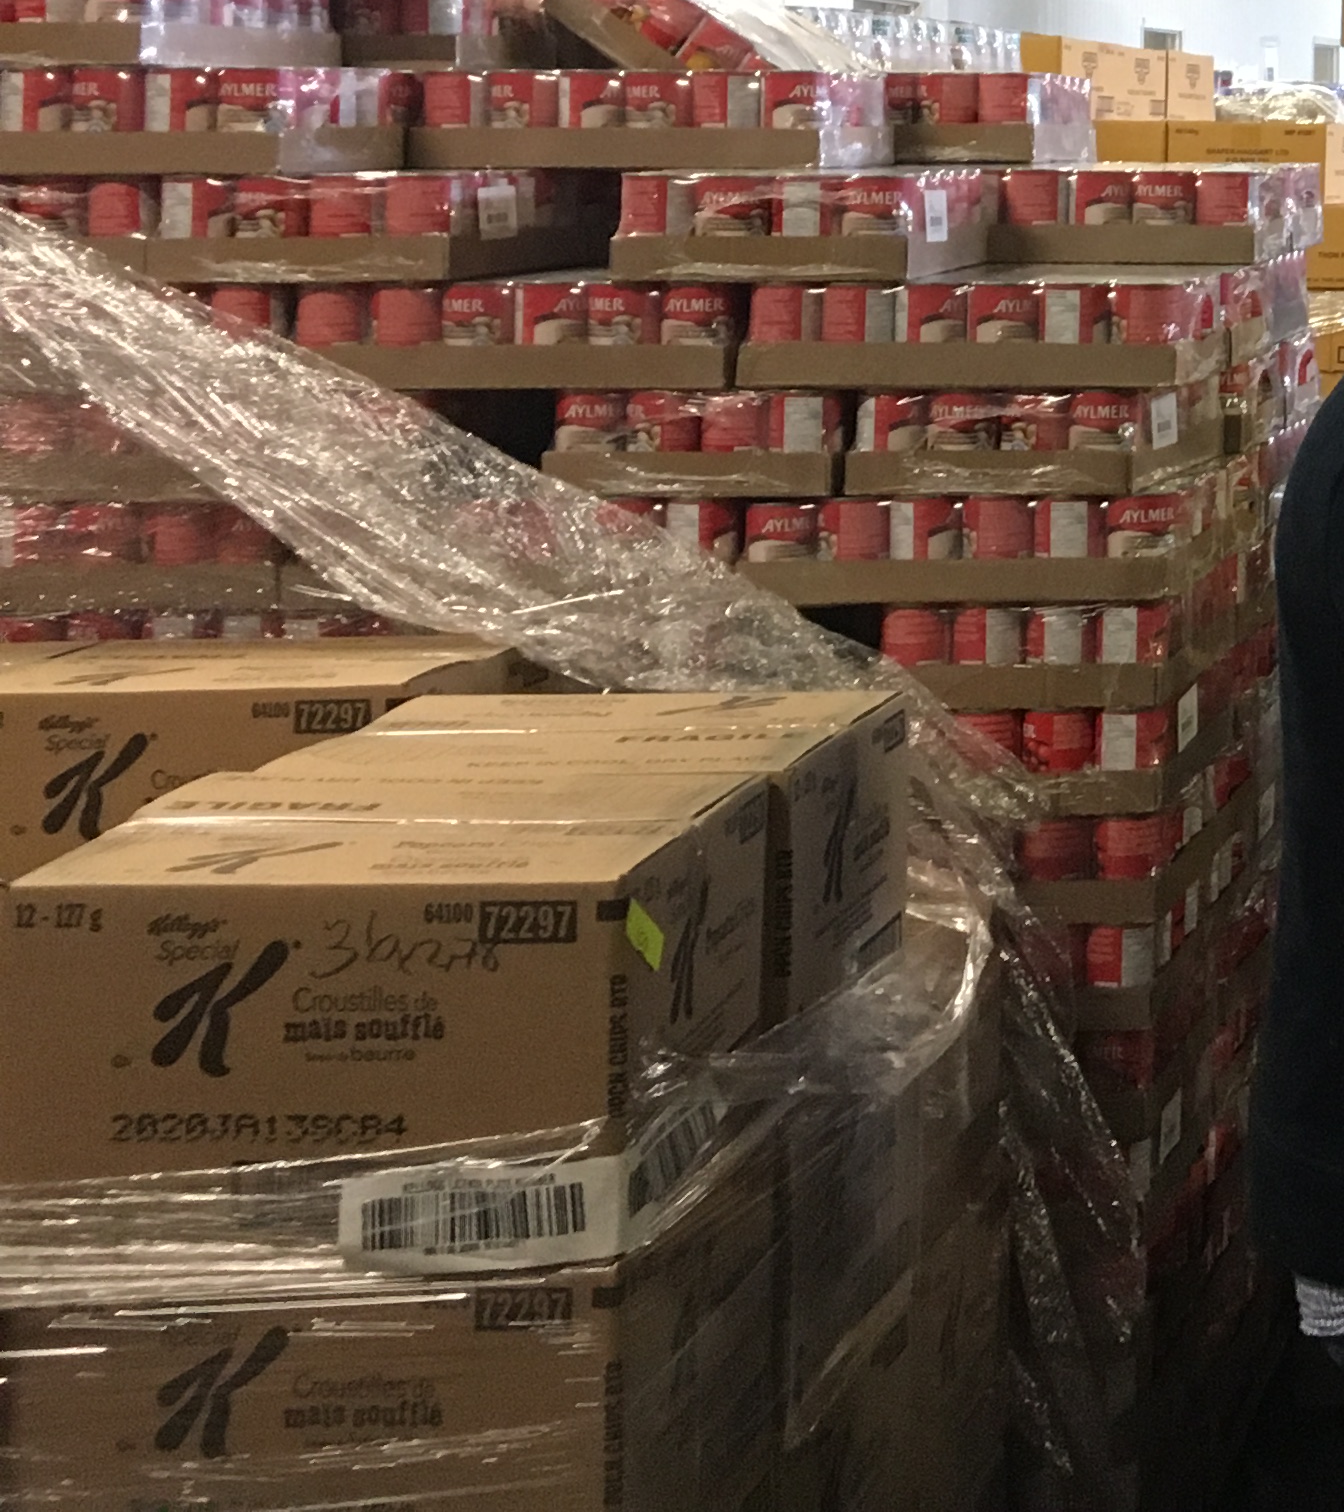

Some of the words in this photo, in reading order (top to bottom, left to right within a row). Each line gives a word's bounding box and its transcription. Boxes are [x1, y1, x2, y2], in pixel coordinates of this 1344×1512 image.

[219, 81, 278, 98] AYLMER
[664, 298, 726, 314] AYLMER
[1073, 401, 1131, 419] AYLMER
[1119, 506, 1176, 524] AYLMER
[297, 701, 368, 731] 72297
[163, 799, 382, 812] FRAGILE
[54, 902, 86, 929] 127
[423, 901, 474, 925] 64100
[482, 902, 576, 940] 72297
[155, 938, 241, 966] Special
[151, 939, 290, 1078] K
[291, 986, 410, 1015] Croustilles
[354, 1012, 446, 1042] soufflé
[476, 1291, 570, 1329] 72297
